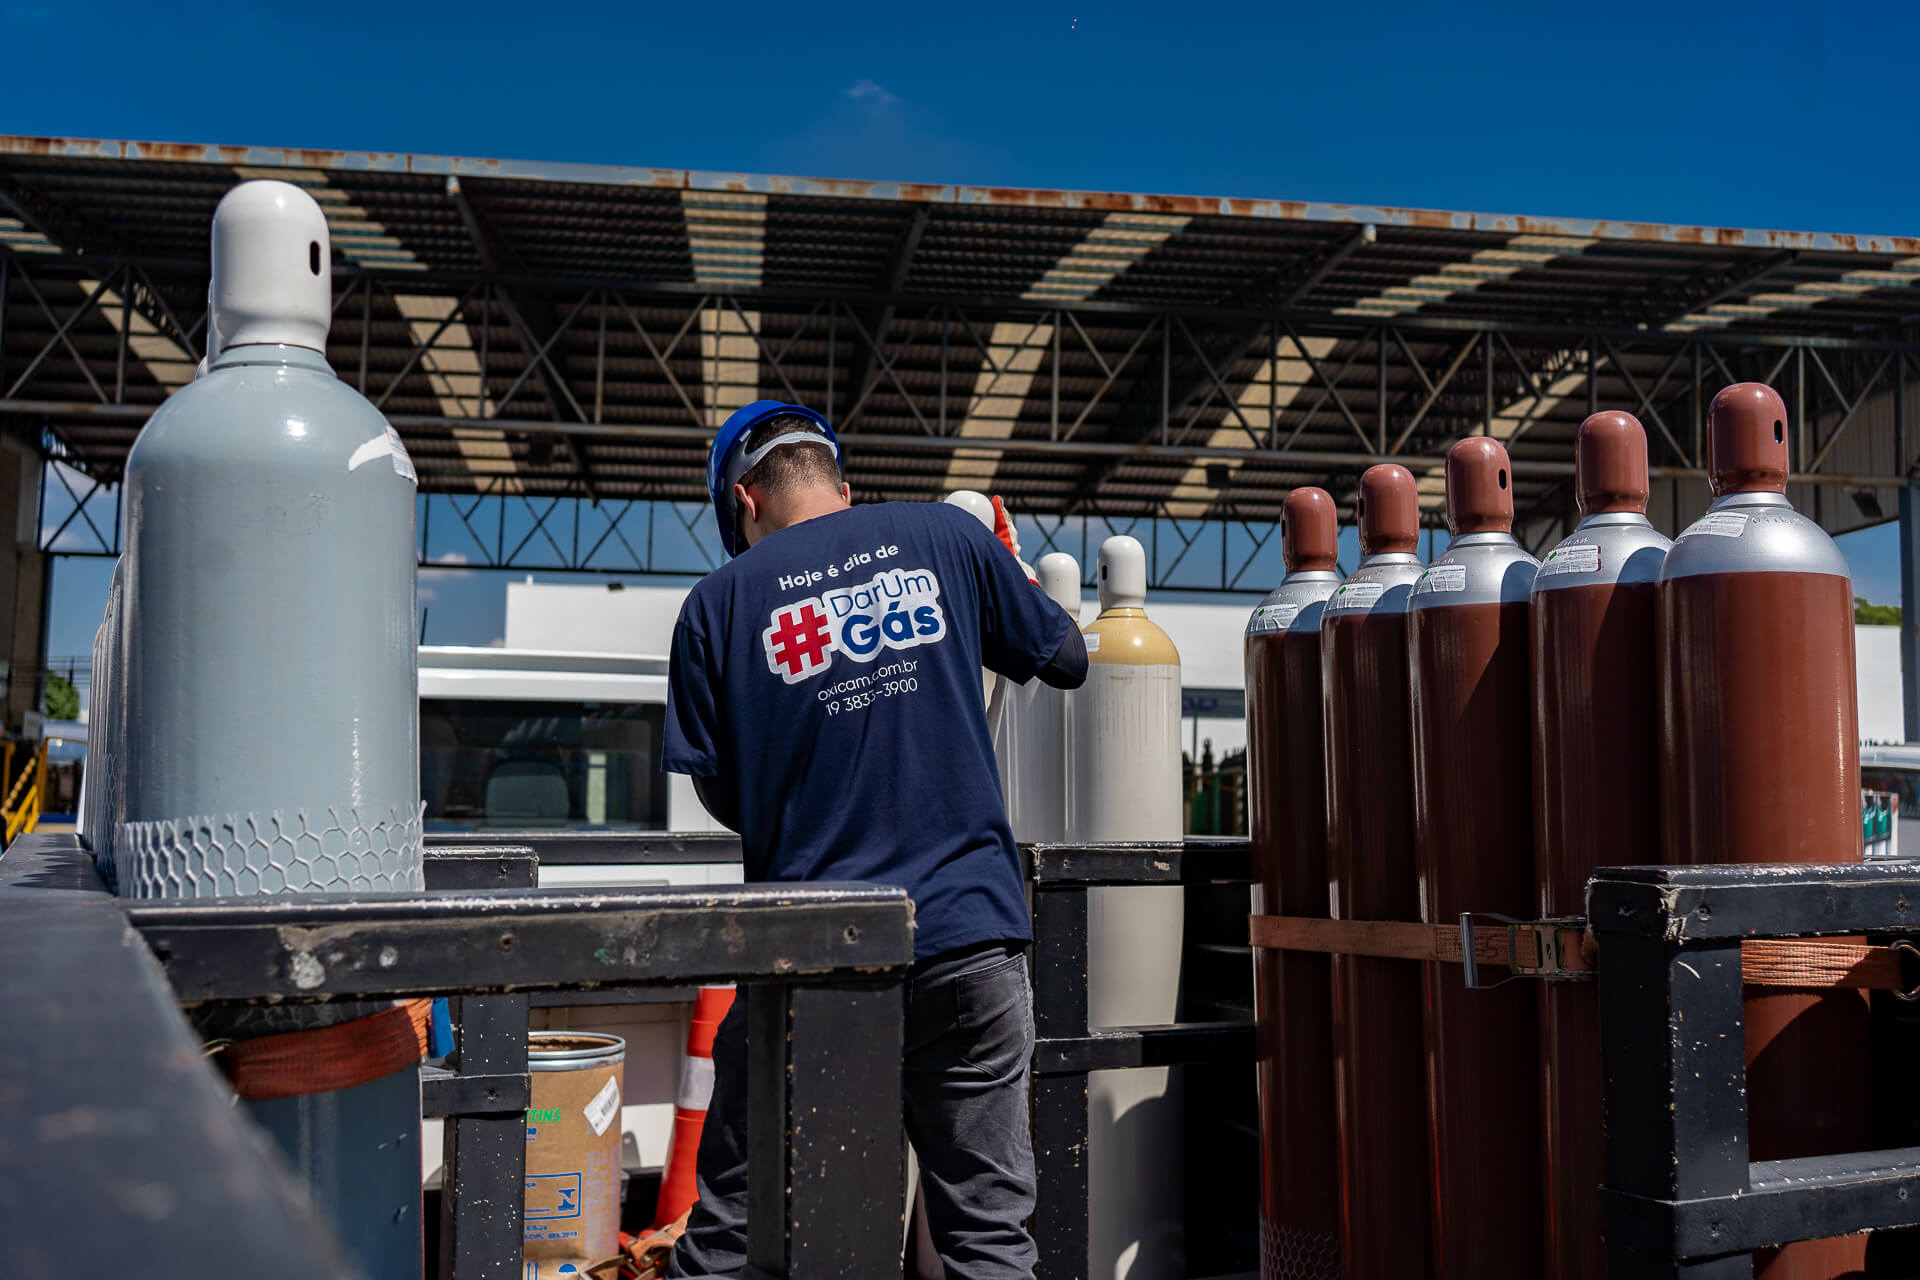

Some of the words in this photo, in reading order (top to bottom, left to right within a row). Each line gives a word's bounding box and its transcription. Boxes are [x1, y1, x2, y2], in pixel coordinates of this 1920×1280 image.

[778, 570, 823, 591] Hoje
[827, 564, 839, 578] é
[843, 553, 872, 572] dia
[875, 544, 899, 559] de
[841, 601, 940, 655] Gás
[817, 659, 918, 701] oxicam.com.br
[825, 701, 840, 716] 19
[844, 677, 918, 712] 3833-3900
